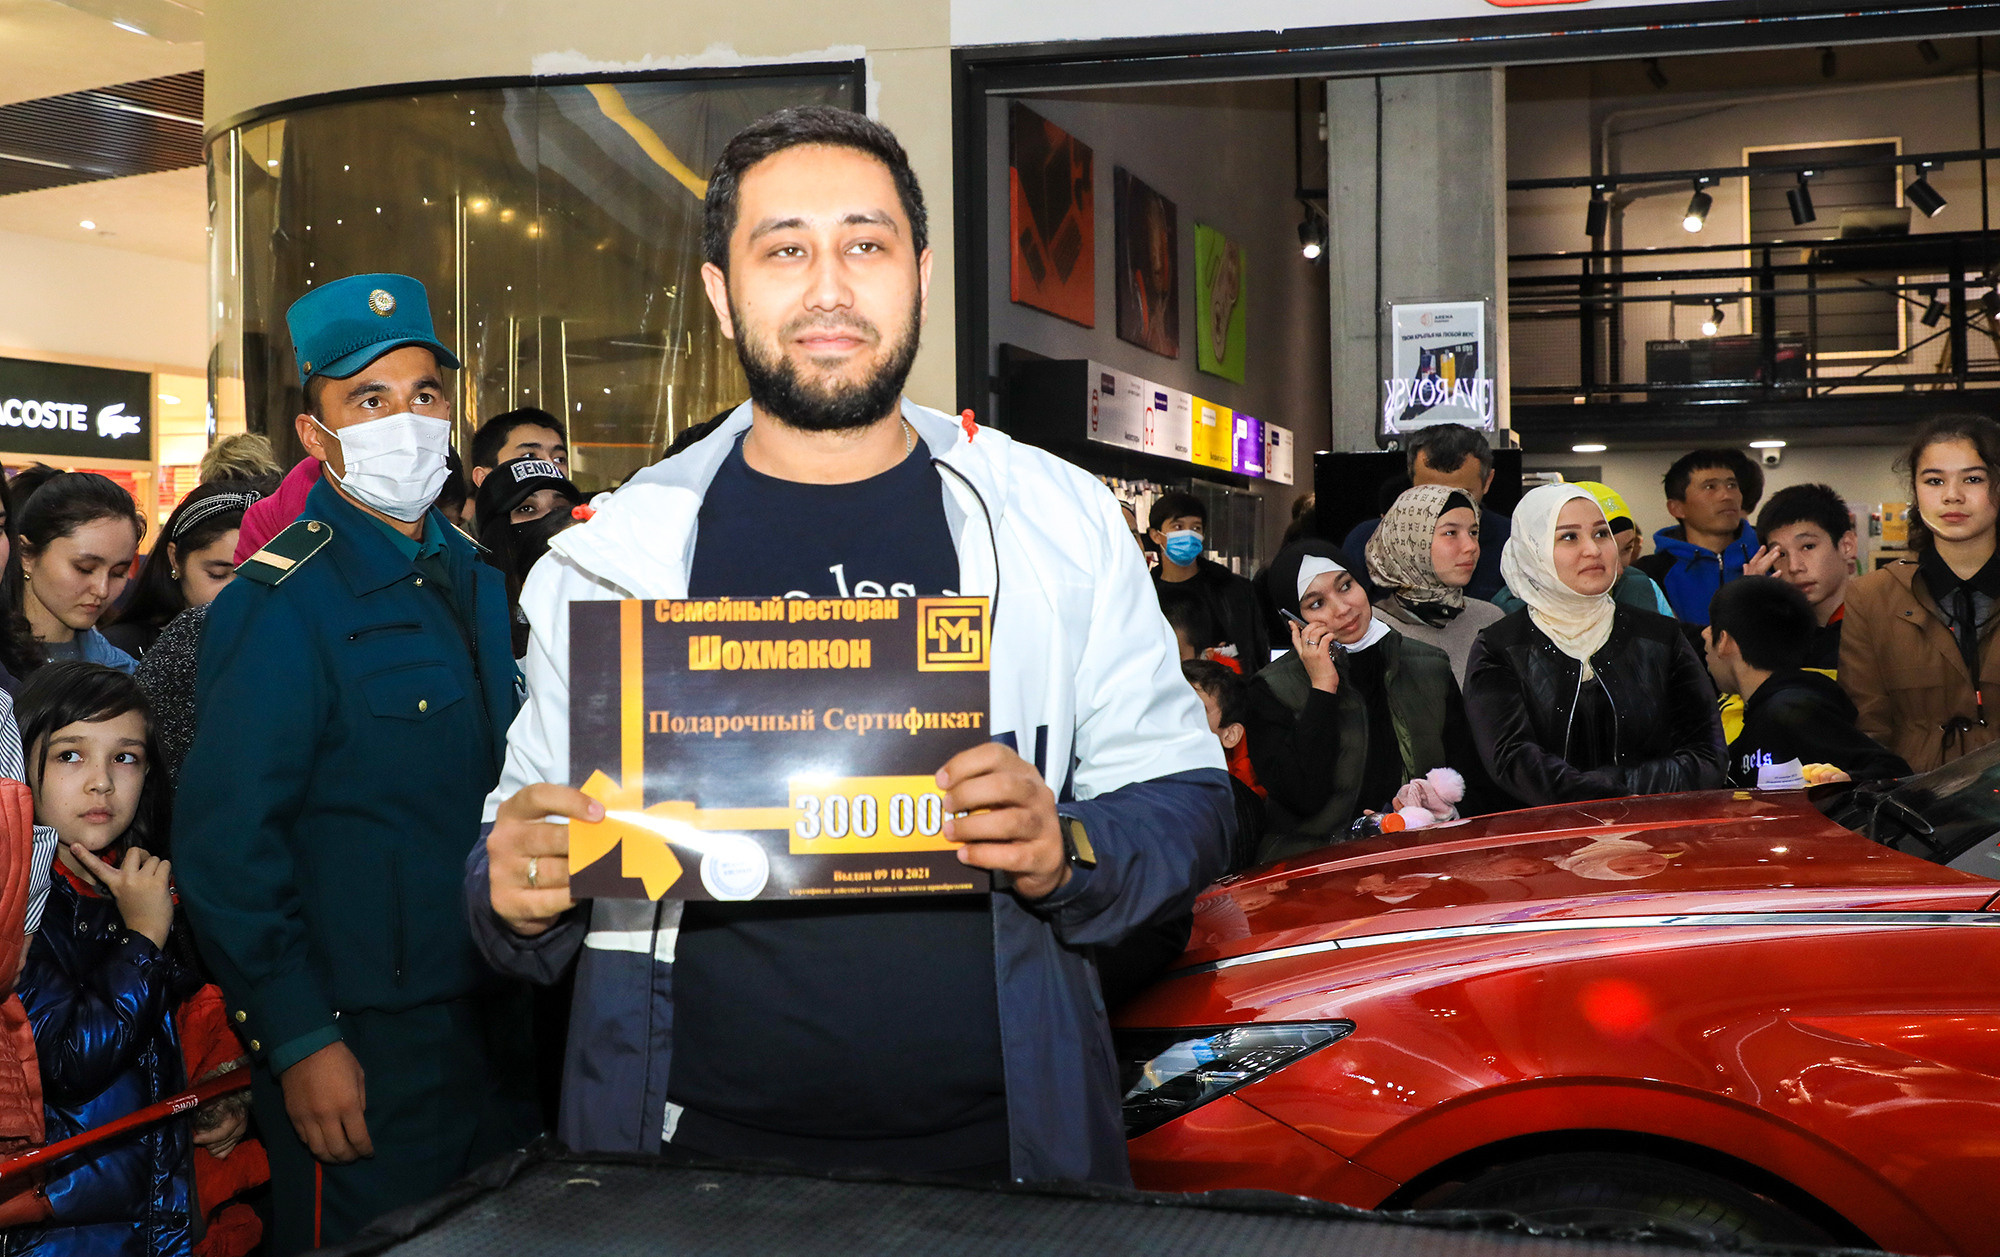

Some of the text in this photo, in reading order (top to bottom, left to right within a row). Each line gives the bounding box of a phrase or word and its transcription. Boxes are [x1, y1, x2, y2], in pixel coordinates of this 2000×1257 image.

[513, 461, 562, 478] FENDI
[654, 596, 899, 624] Семейный ресторан
[688, 635, 872, 671] Шохмакон
[649, 707, 984, 738] Подарочный Сертификат
[795, 793, 968, 839] 300 00
[833, 867, 931, 882] Выдан 09 10 2021
